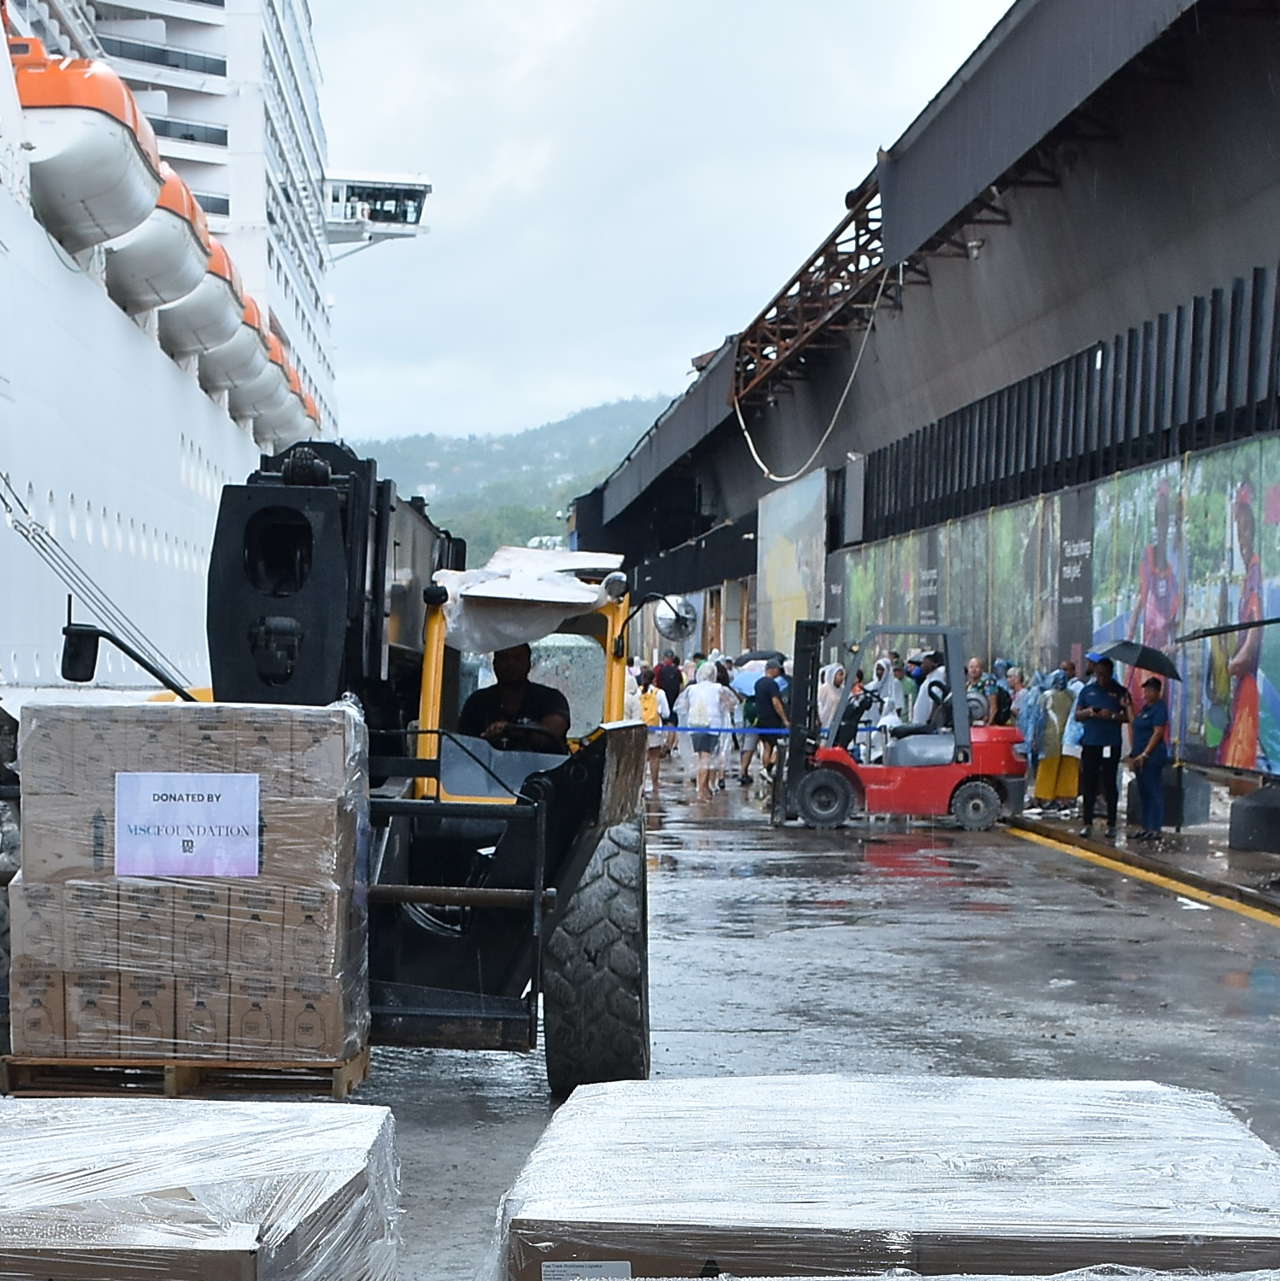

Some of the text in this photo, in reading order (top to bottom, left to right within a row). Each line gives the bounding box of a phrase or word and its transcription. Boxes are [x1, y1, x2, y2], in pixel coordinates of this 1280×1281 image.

[153, 793, 221, 803] DONATED BY
[128, 823, 249, 837] MSCFOUNDATION
